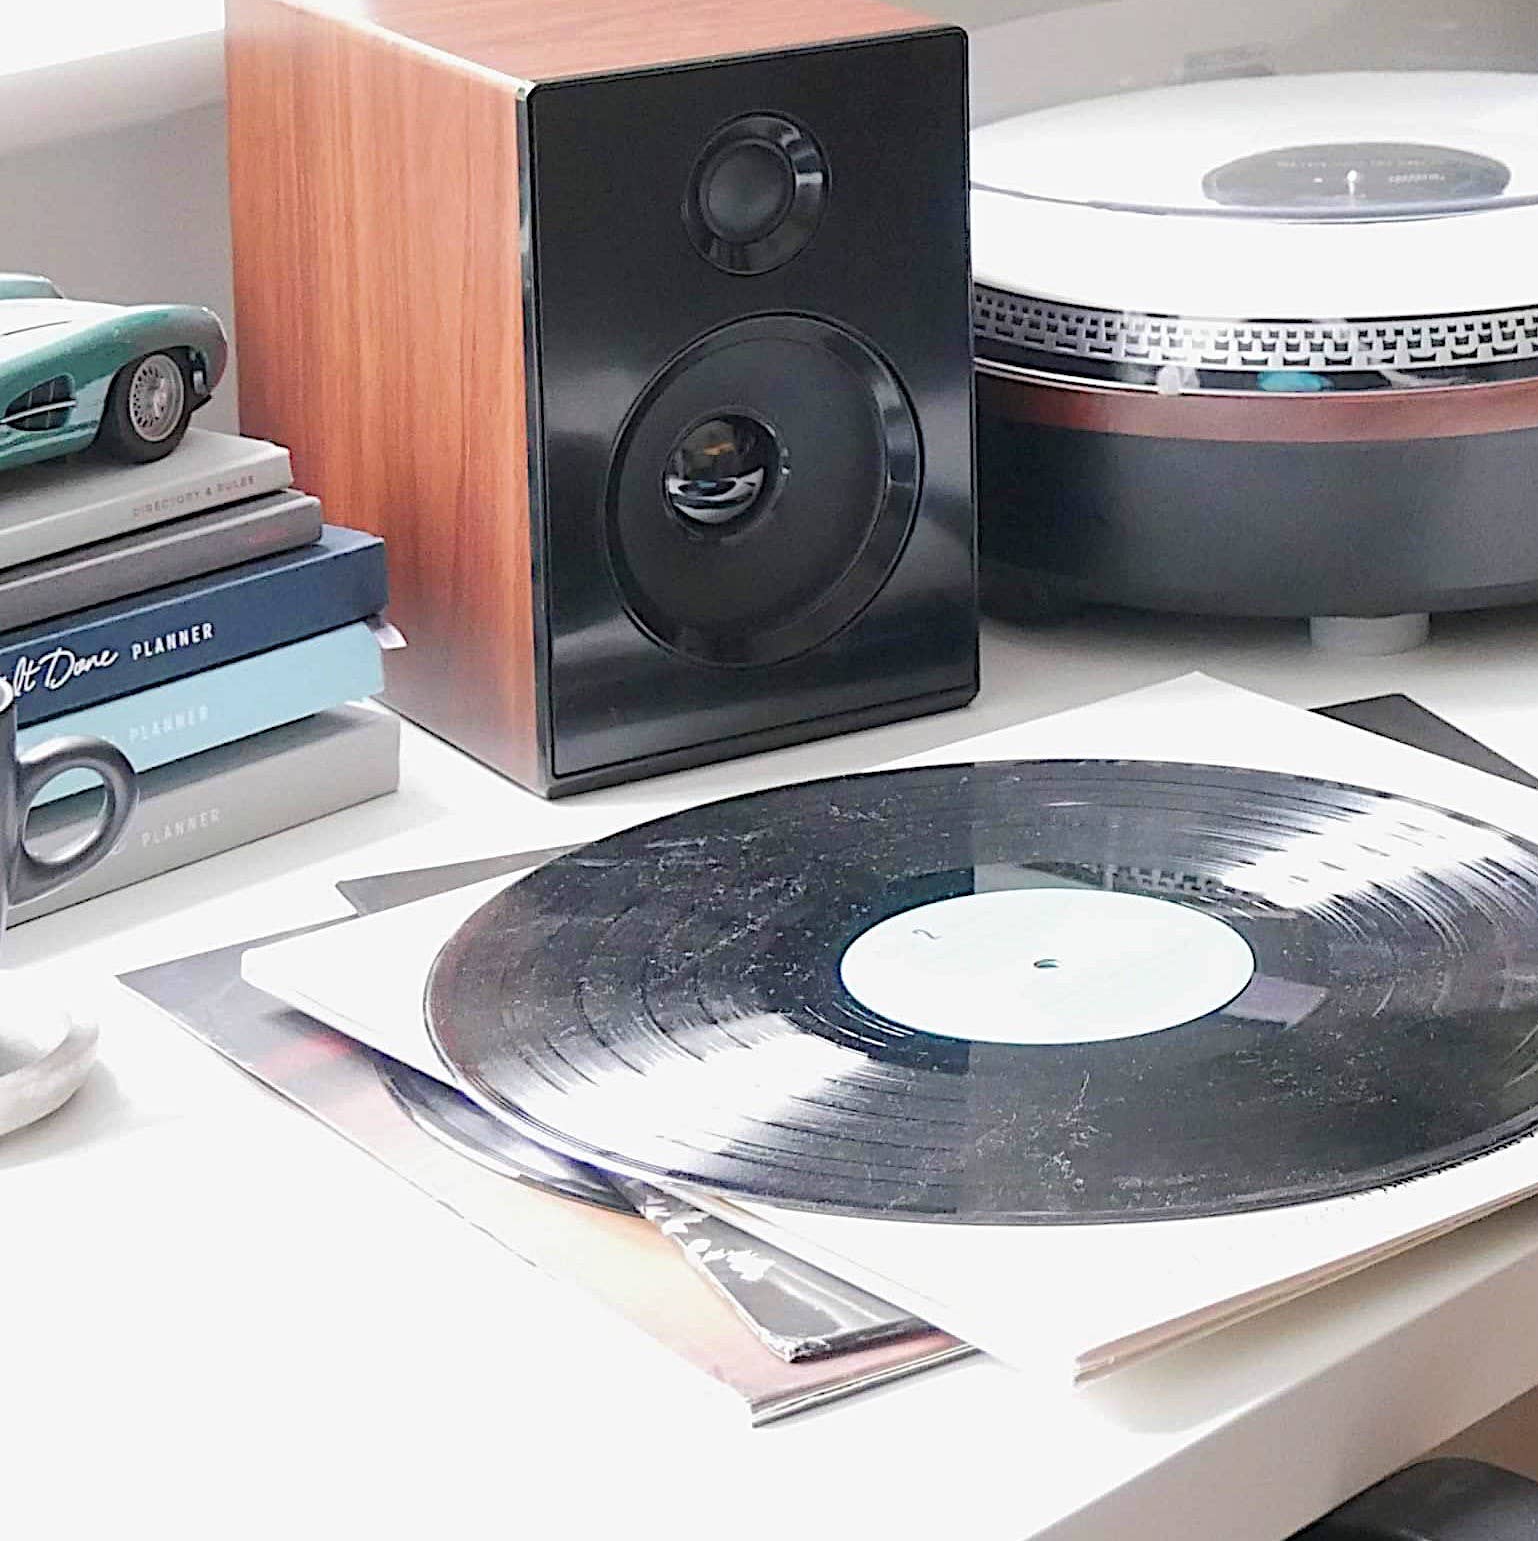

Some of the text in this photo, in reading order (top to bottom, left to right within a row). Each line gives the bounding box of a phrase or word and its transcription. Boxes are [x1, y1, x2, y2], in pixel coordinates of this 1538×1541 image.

[38, 645, 119, 690] Done
[131, 621, 214, 661] PLANNER
[128, 704, 209, 744] PLANNER
[141, 806, 221, 848] PLANNER
